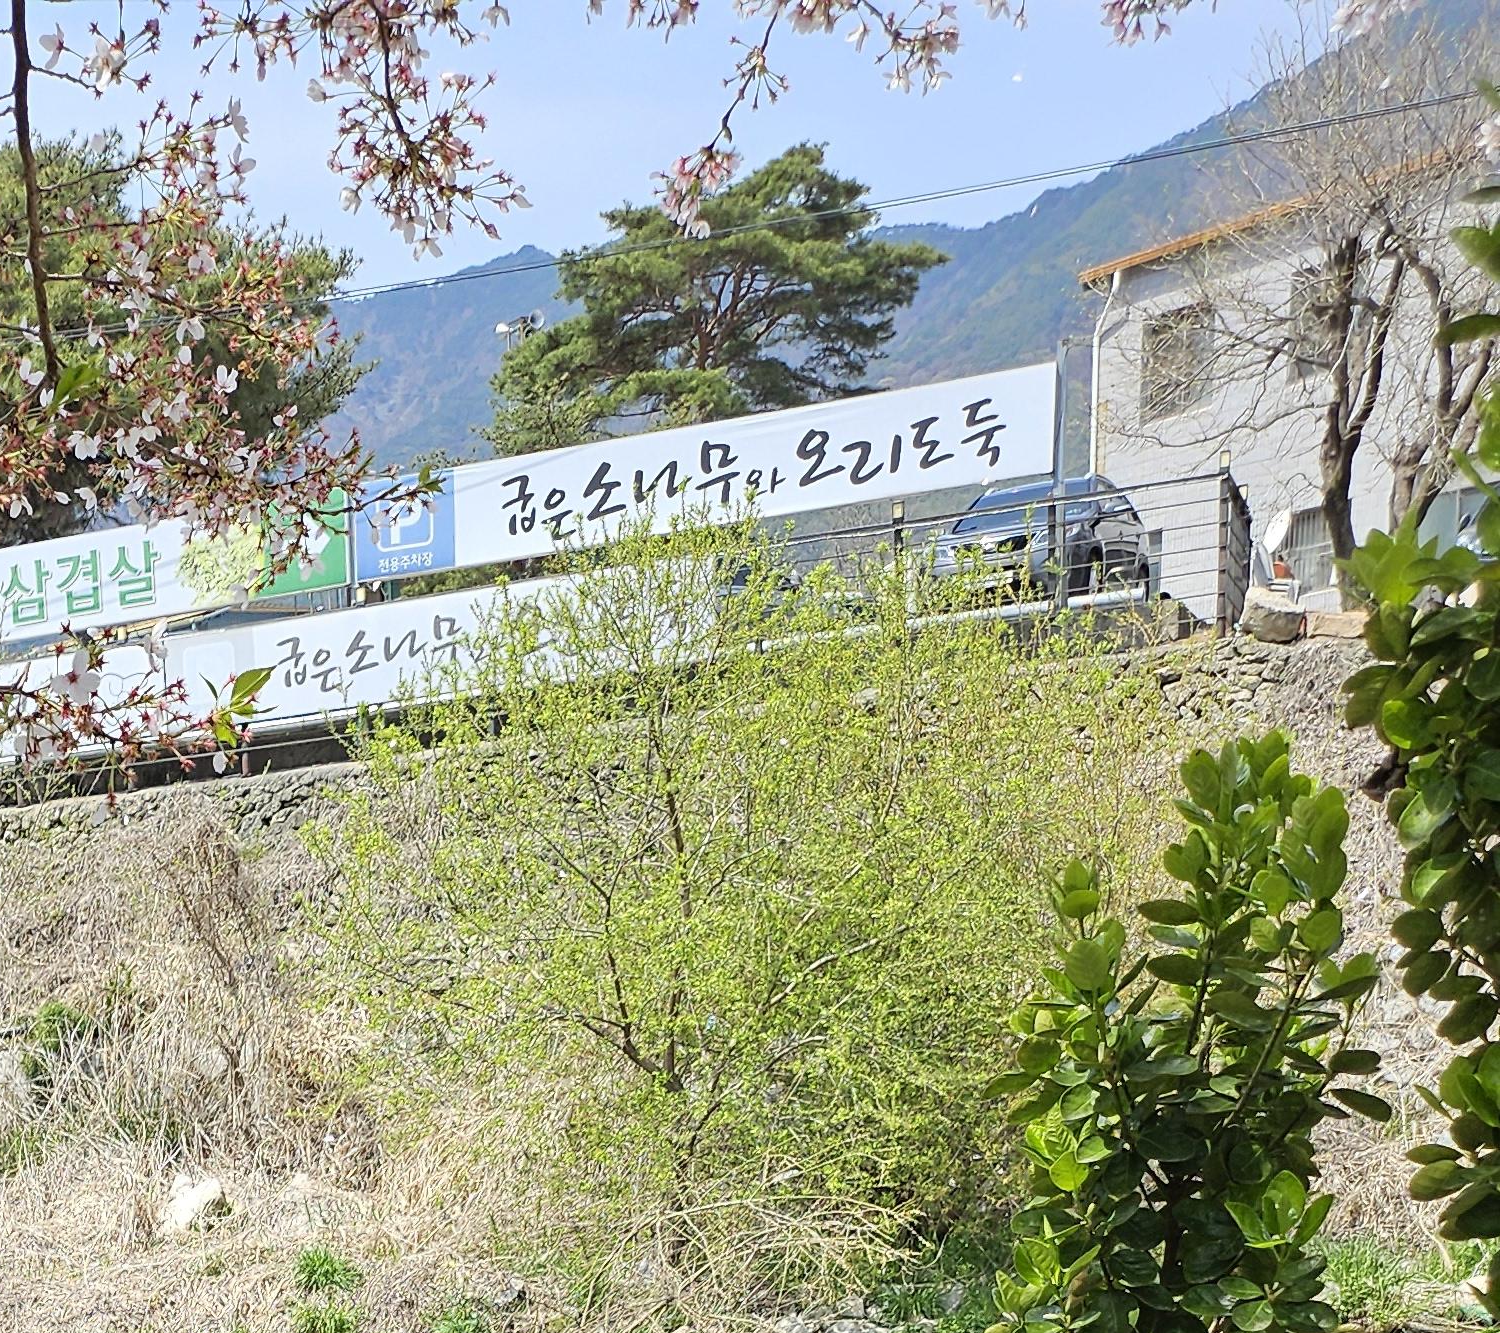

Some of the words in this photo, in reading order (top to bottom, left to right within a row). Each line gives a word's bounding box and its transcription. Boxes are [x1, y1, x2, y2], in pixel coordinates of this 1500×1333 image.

[500, 474, 576, 541] 굽은
[377, 551, 434, 574] 전용주차장
[276, 636, 342, 691] 굽은
